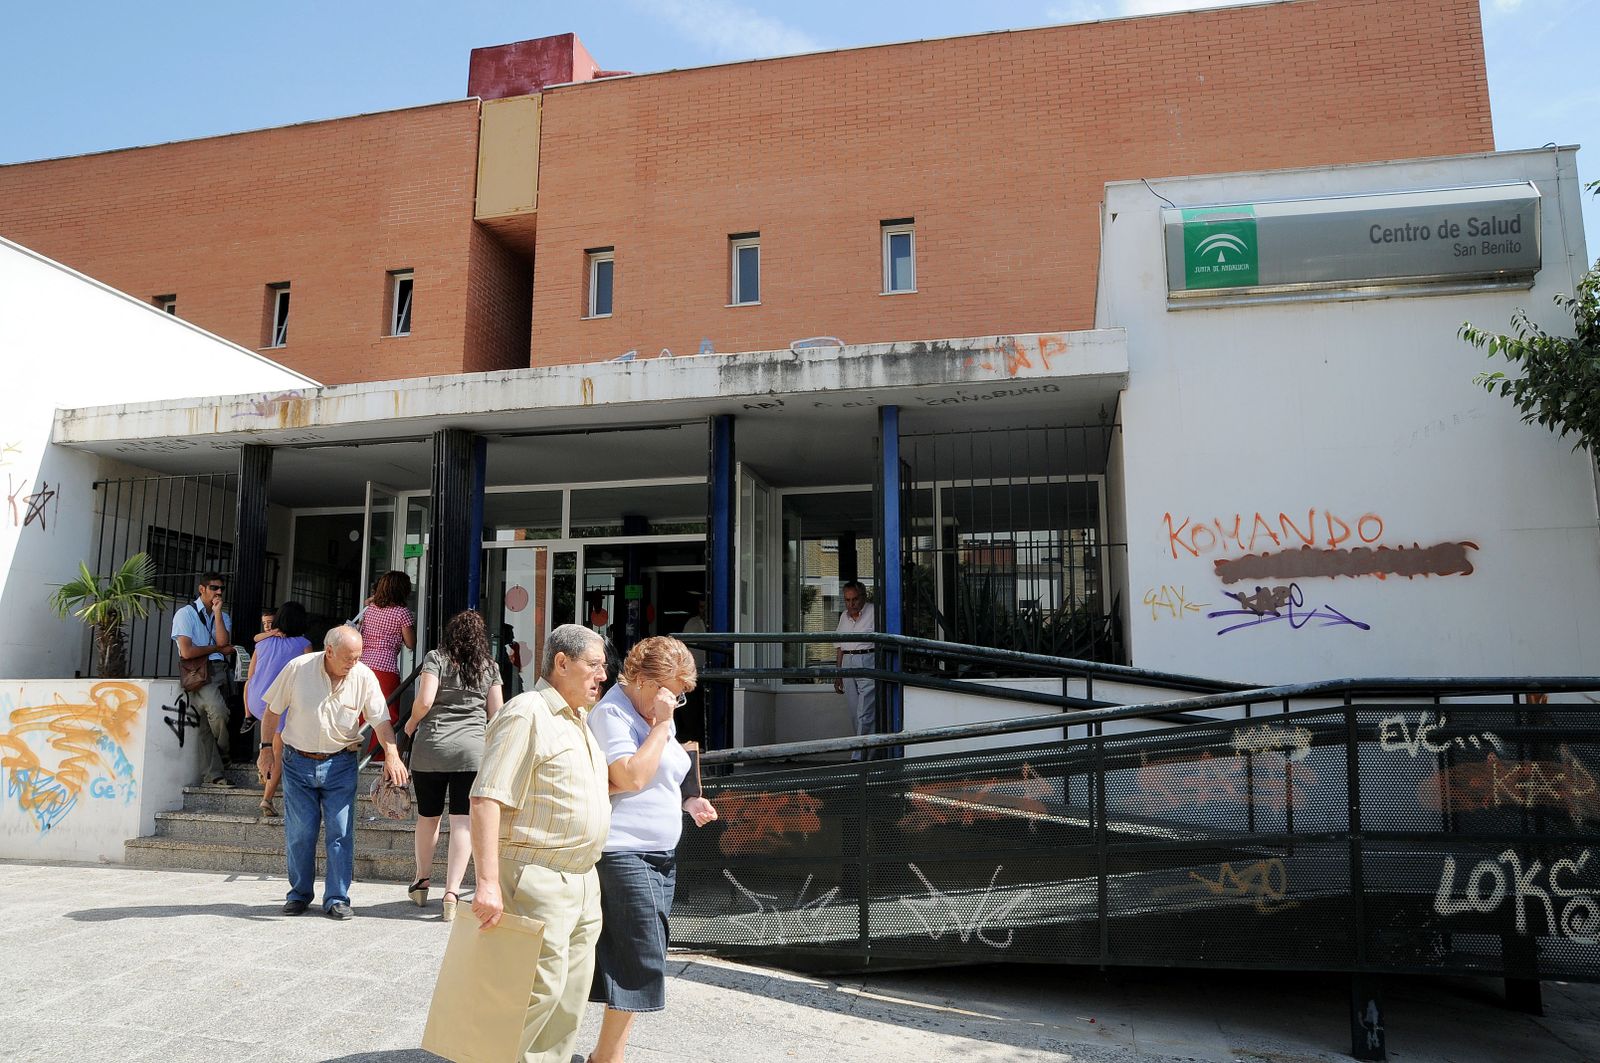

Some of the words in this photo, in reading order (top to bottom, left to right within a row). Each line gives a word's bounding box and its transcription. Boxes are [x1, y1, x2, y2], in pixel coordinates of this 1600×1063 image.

[1369, 223, 1431, 244] Centro
[1437, 219, 1460, 239] de
[1467, 214, 1522, 237] Salud
[1453, 243, 1477, 257] San
[1481, 240, 1522, 256] Benito
[1163, 508, 1384, 559] KOMANDO
